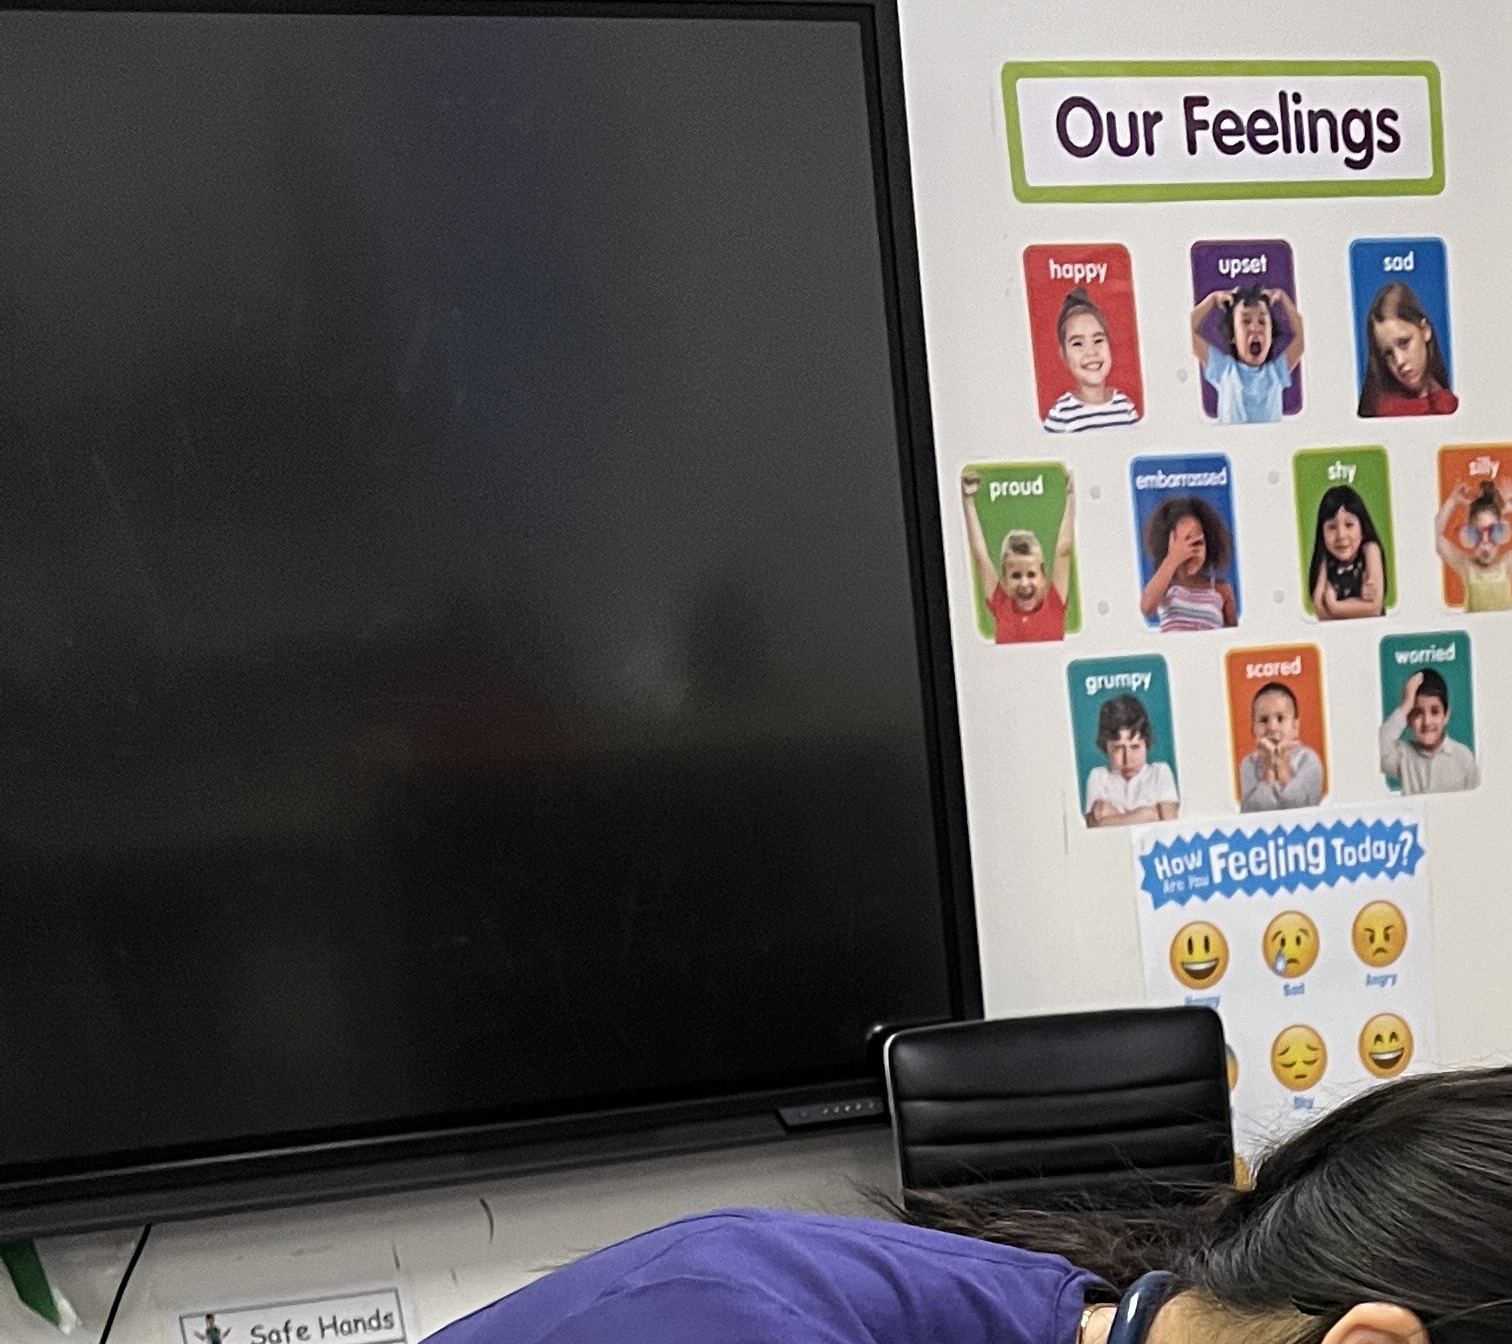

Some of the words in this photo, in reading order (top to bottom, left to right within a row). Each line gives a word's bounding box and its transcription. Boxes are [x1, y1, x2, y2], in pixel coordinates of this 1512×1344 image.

[1056, 96, 1161, 159] Our
[1183, 90, 1401, 169] Feelings
[1049, 260, 1108, 282] happy
[1218, 255, 1267, 277] upset
[1383, 253, 1414, 272] sad
[1136, 469, 1227, 489] embarrassed
[1327, 462, 1356, 482] shy
[989, 476, 1043, 498] proud
[1395, 645, 1455, 664] worried
[1246, 658, 1301, 678] scared
[1085, 670, 1152, 694] grumpy
[1154, 848, 1202, 881] How
[1208, 835, 1325, 885] Feeling
[1331, 829, 1413, 868] Today?
[318, 1309, 395, 1339] Hands
